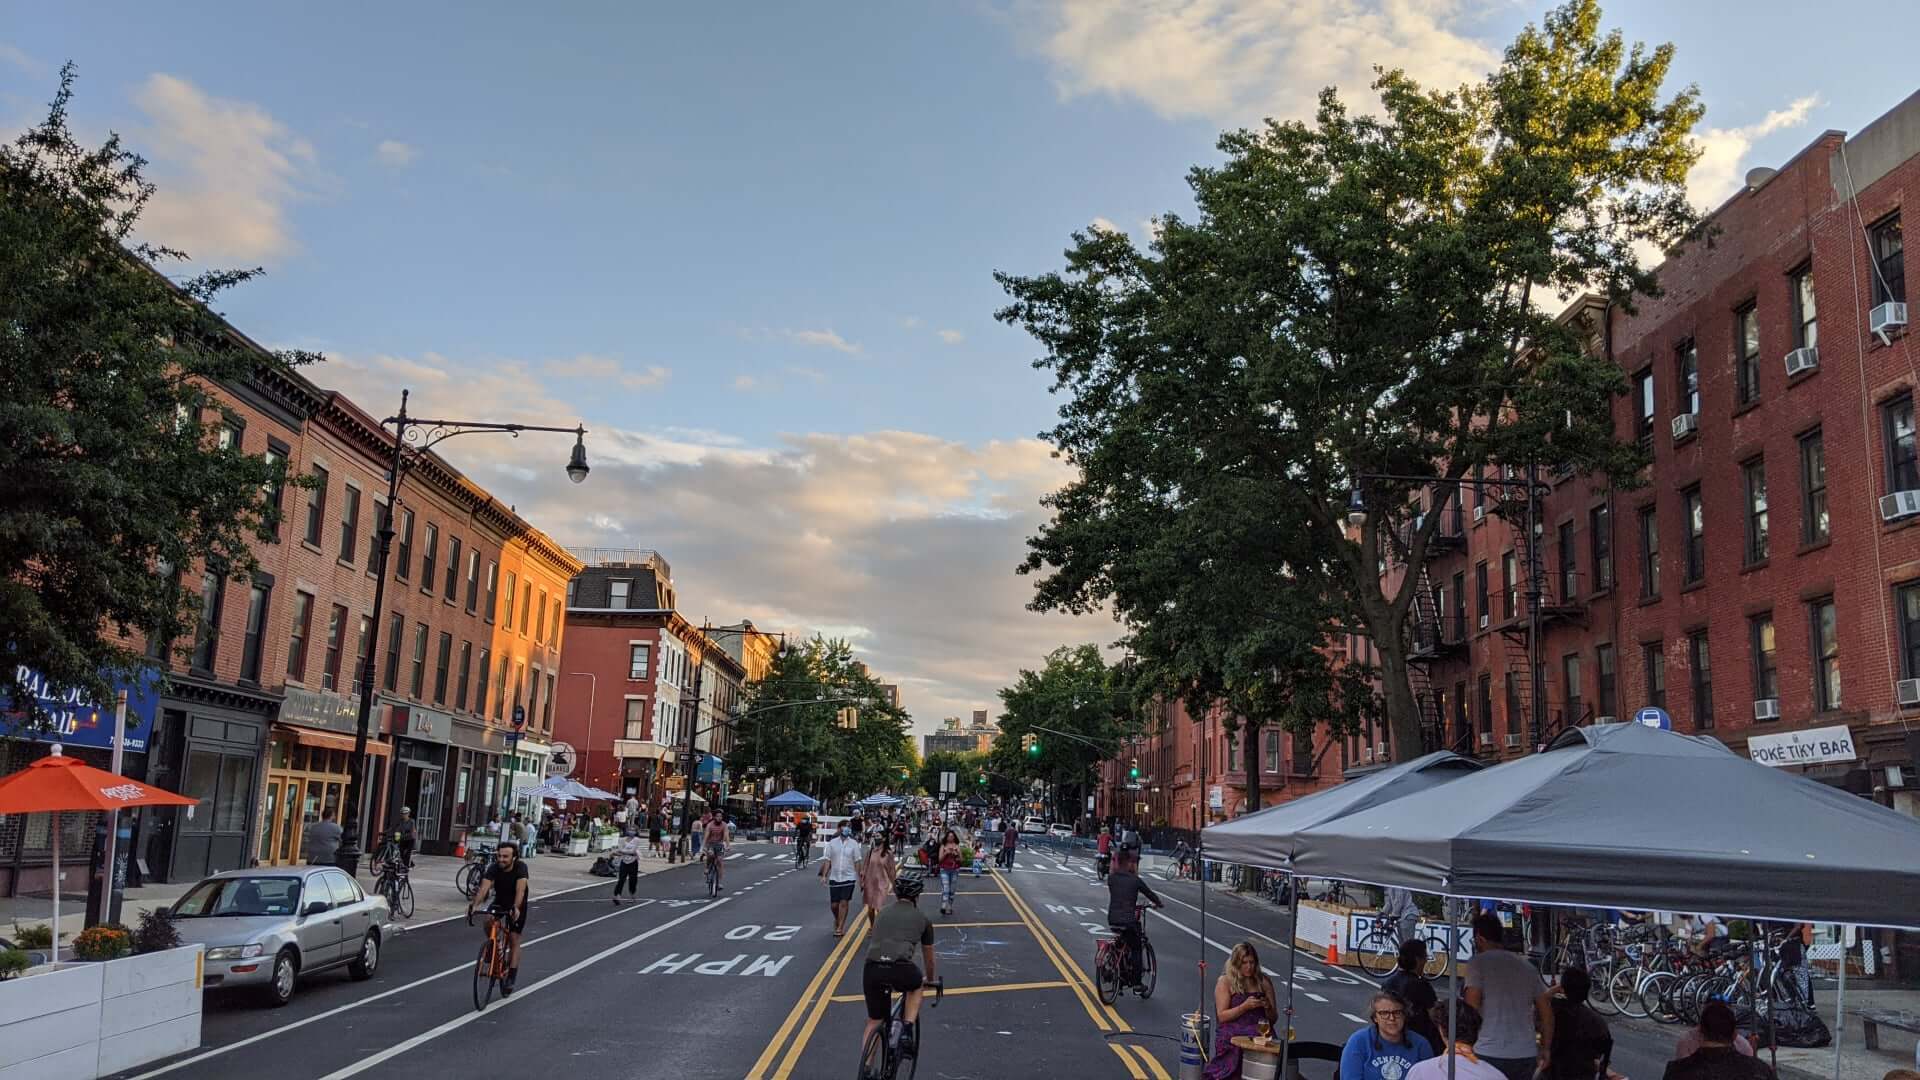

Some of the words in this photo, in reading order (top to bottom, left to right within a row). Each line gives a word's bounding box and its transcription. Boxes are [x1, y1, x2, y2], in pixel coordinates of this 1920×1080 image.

[1787, 743, 1816, 760] TIKY
[1819, 740, 1851, 756] BAR
[724, 924, 803, 941] 20
[637, 953, 795, 977] MPH
